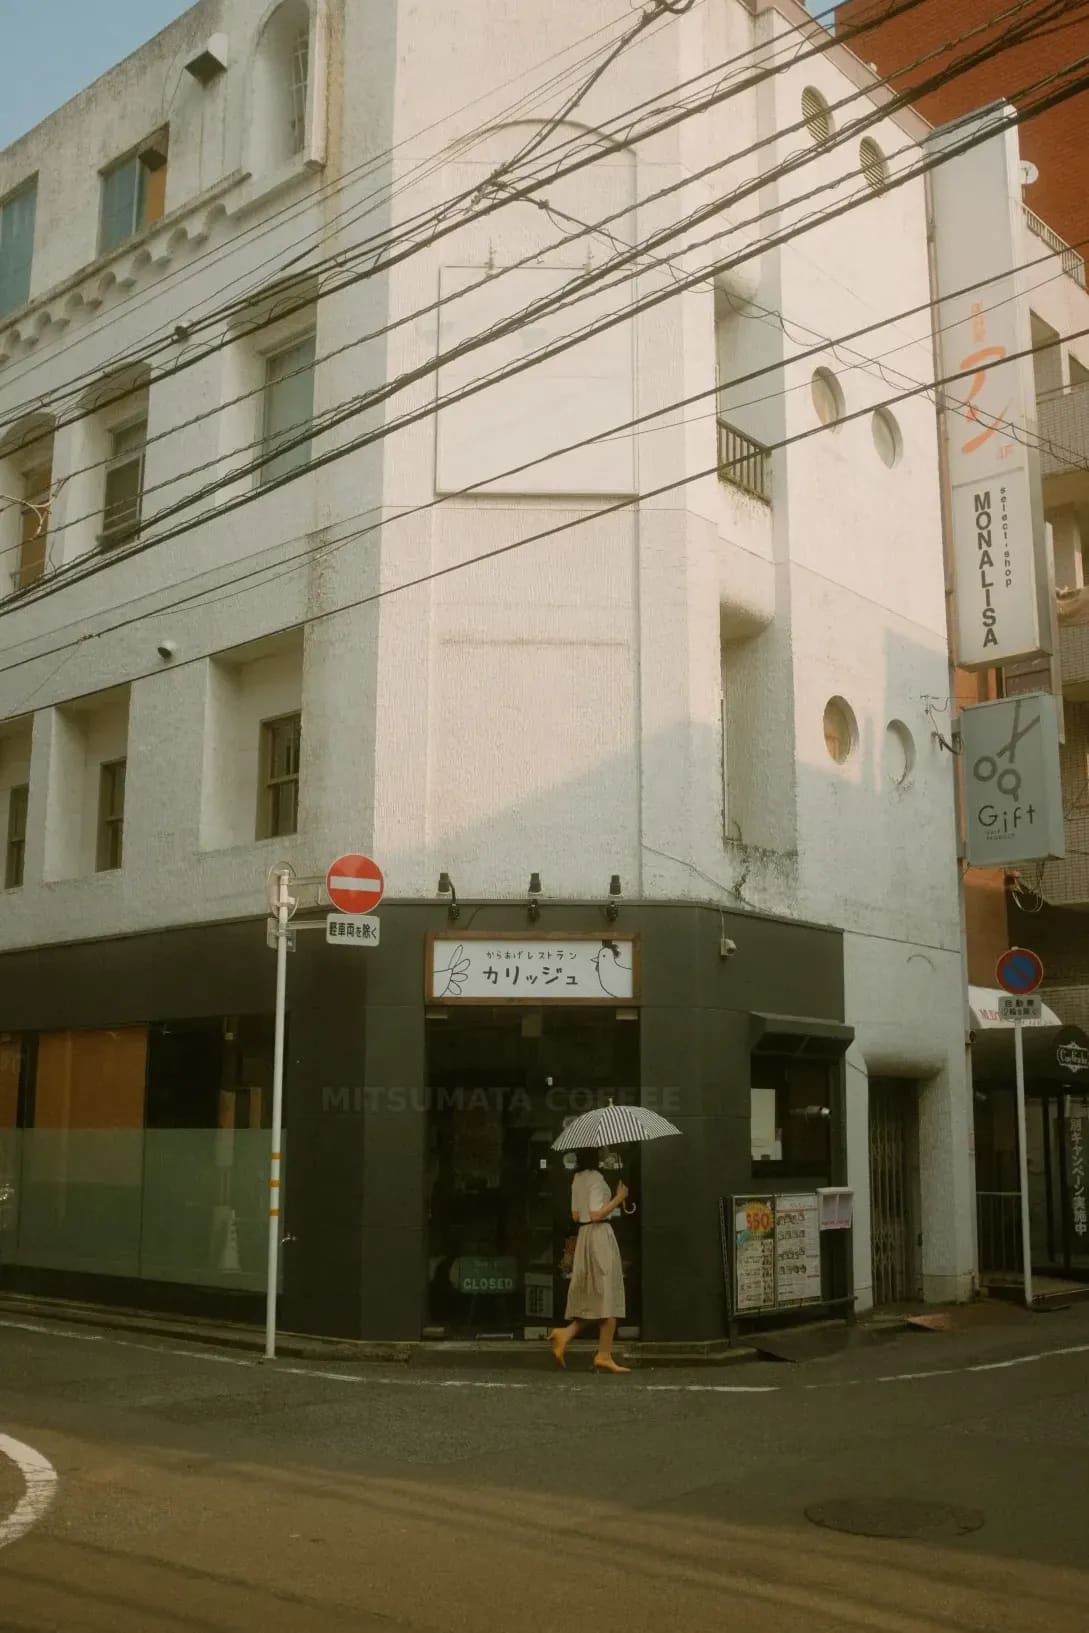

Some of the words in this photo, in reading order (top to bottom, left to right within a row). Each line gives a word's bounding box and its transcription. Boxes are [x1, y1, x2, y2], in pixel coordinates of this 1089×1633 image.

[974, 491, 998, 648] MONALISA
[978, 803, 1036, 833] Gift
[485, 950, 577, 960] からあげレストラン
[482, 966, 579, 985] カリッジュ
[463, 1278, 513, 1290] CLOSED
